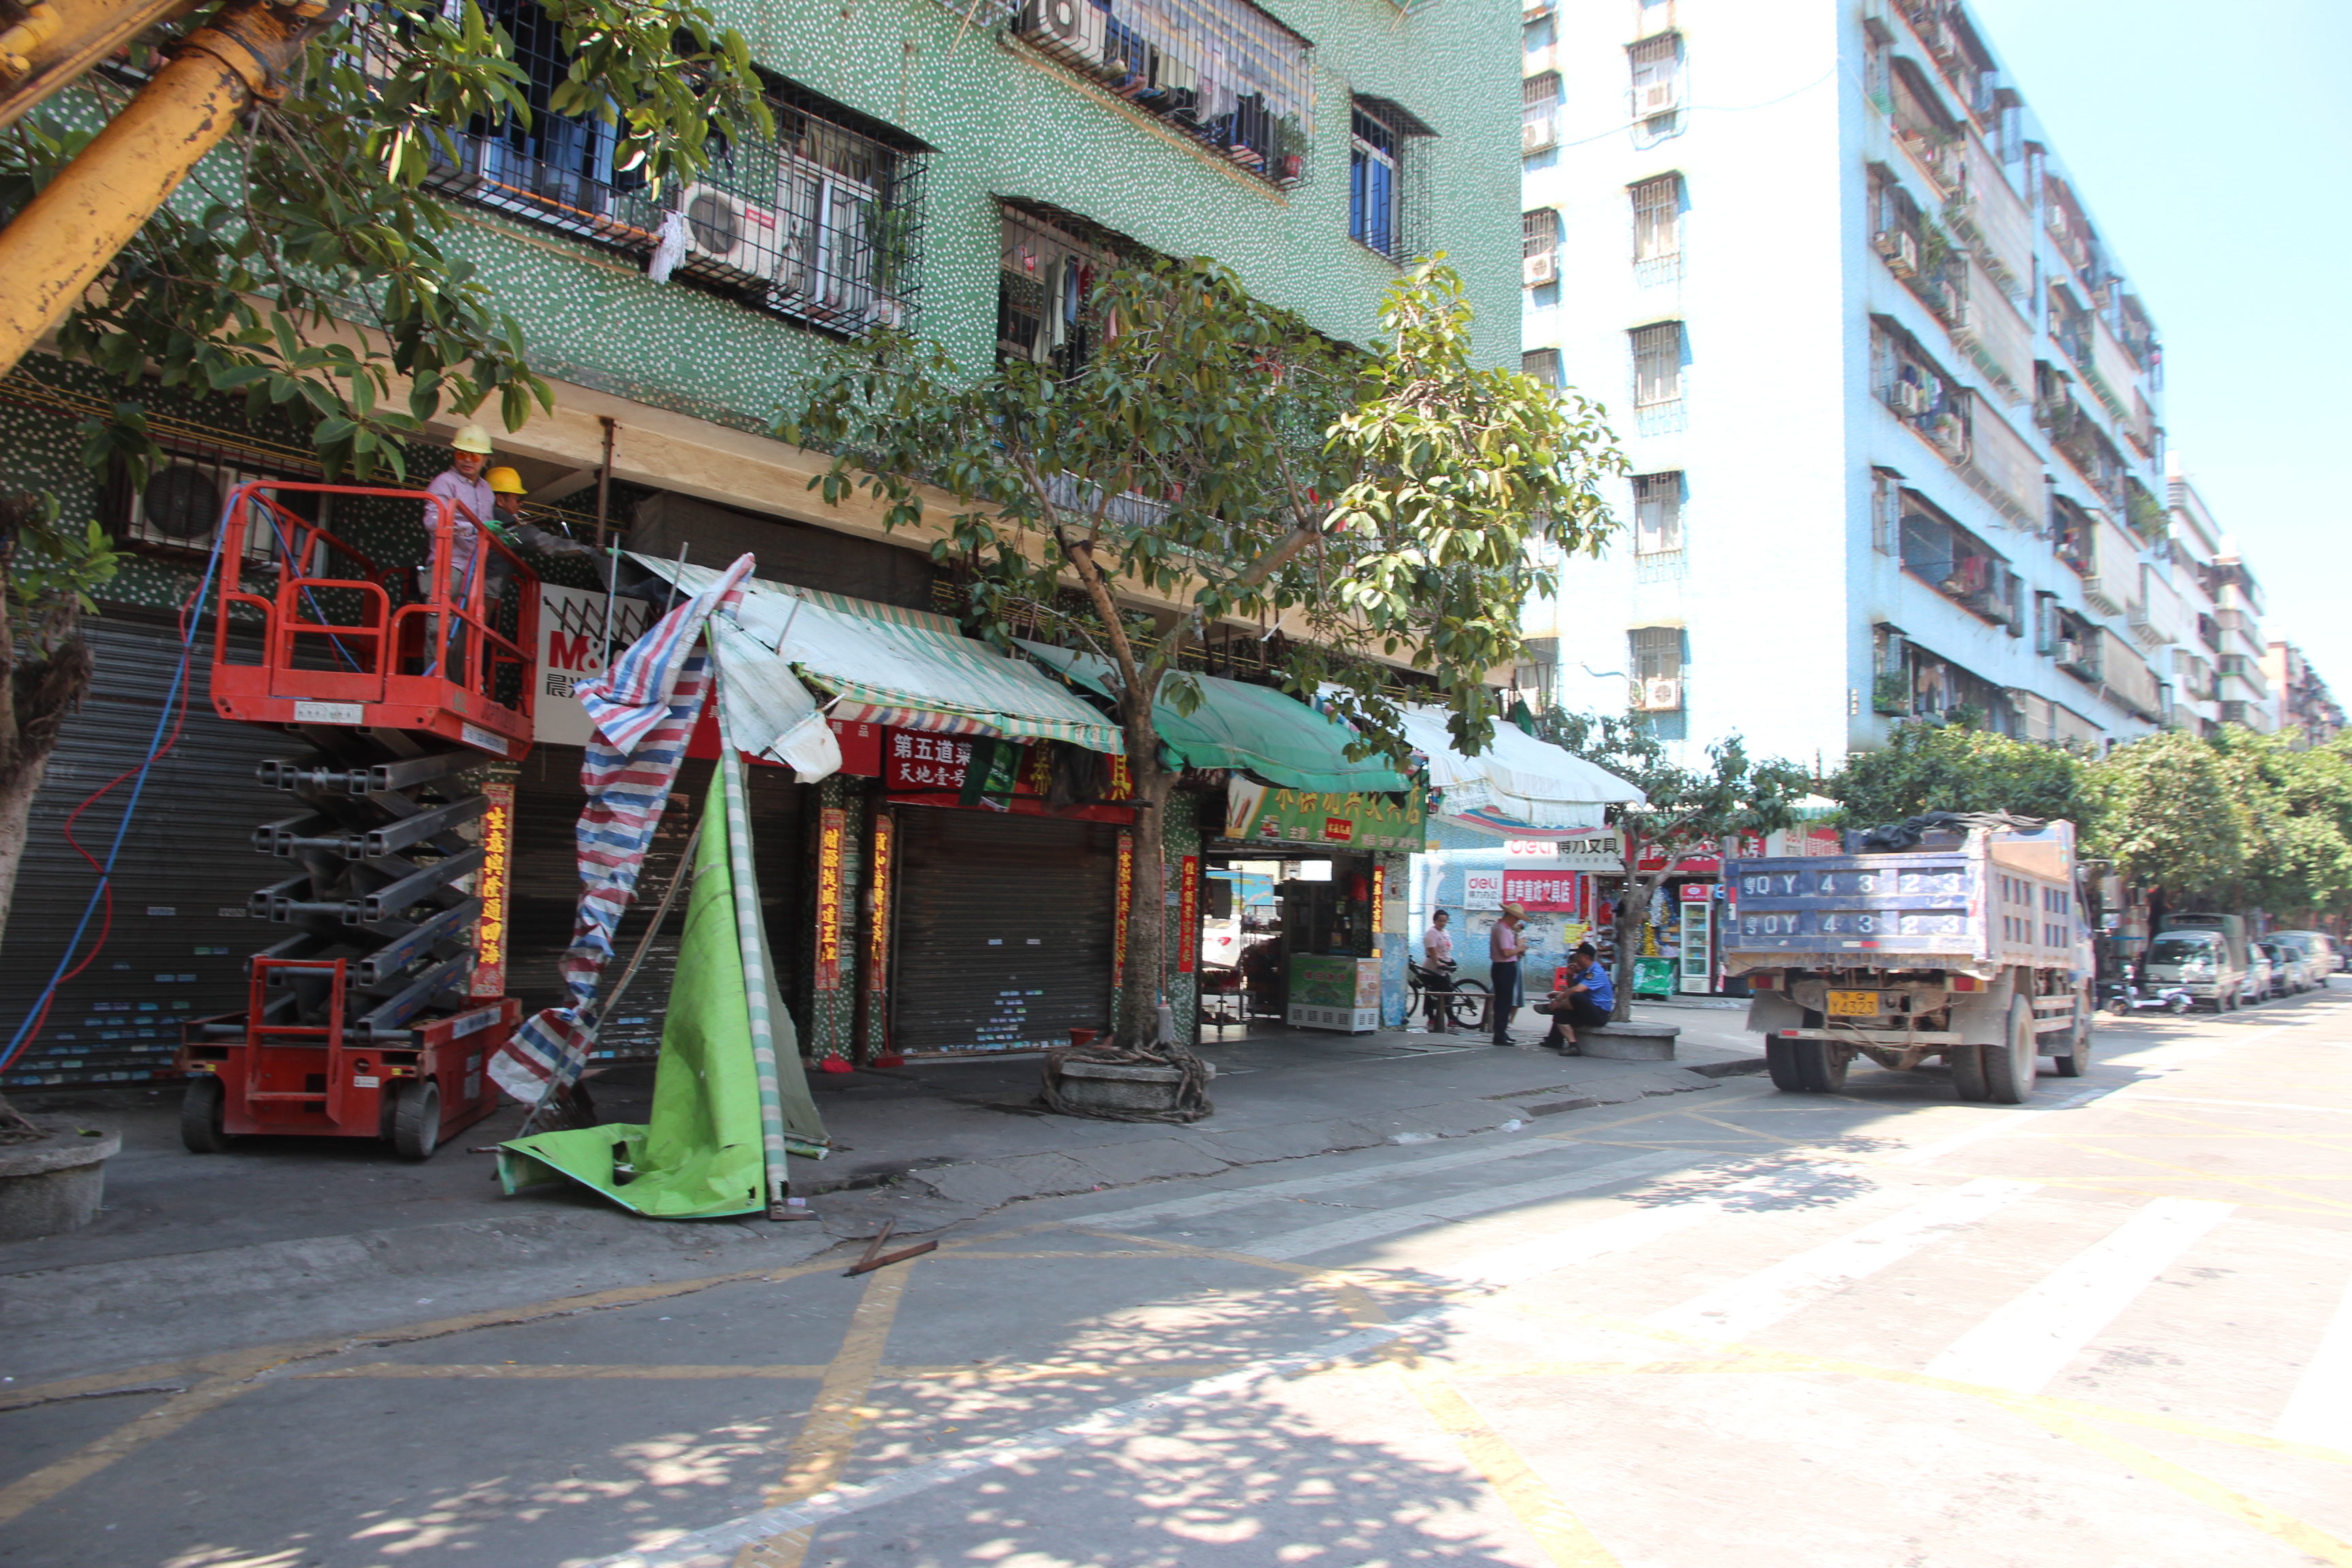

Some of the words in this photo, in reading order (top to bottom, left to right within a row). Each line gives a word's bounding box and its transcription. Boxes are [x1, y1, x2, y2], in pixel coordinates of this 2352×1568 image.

[749, 211, 772, 225] Natonal
[894, 734, 973, 766] 第五道菜
[899, 763, 966, 787] 天地壹号
[1469, 877, 1498, 889] deli
